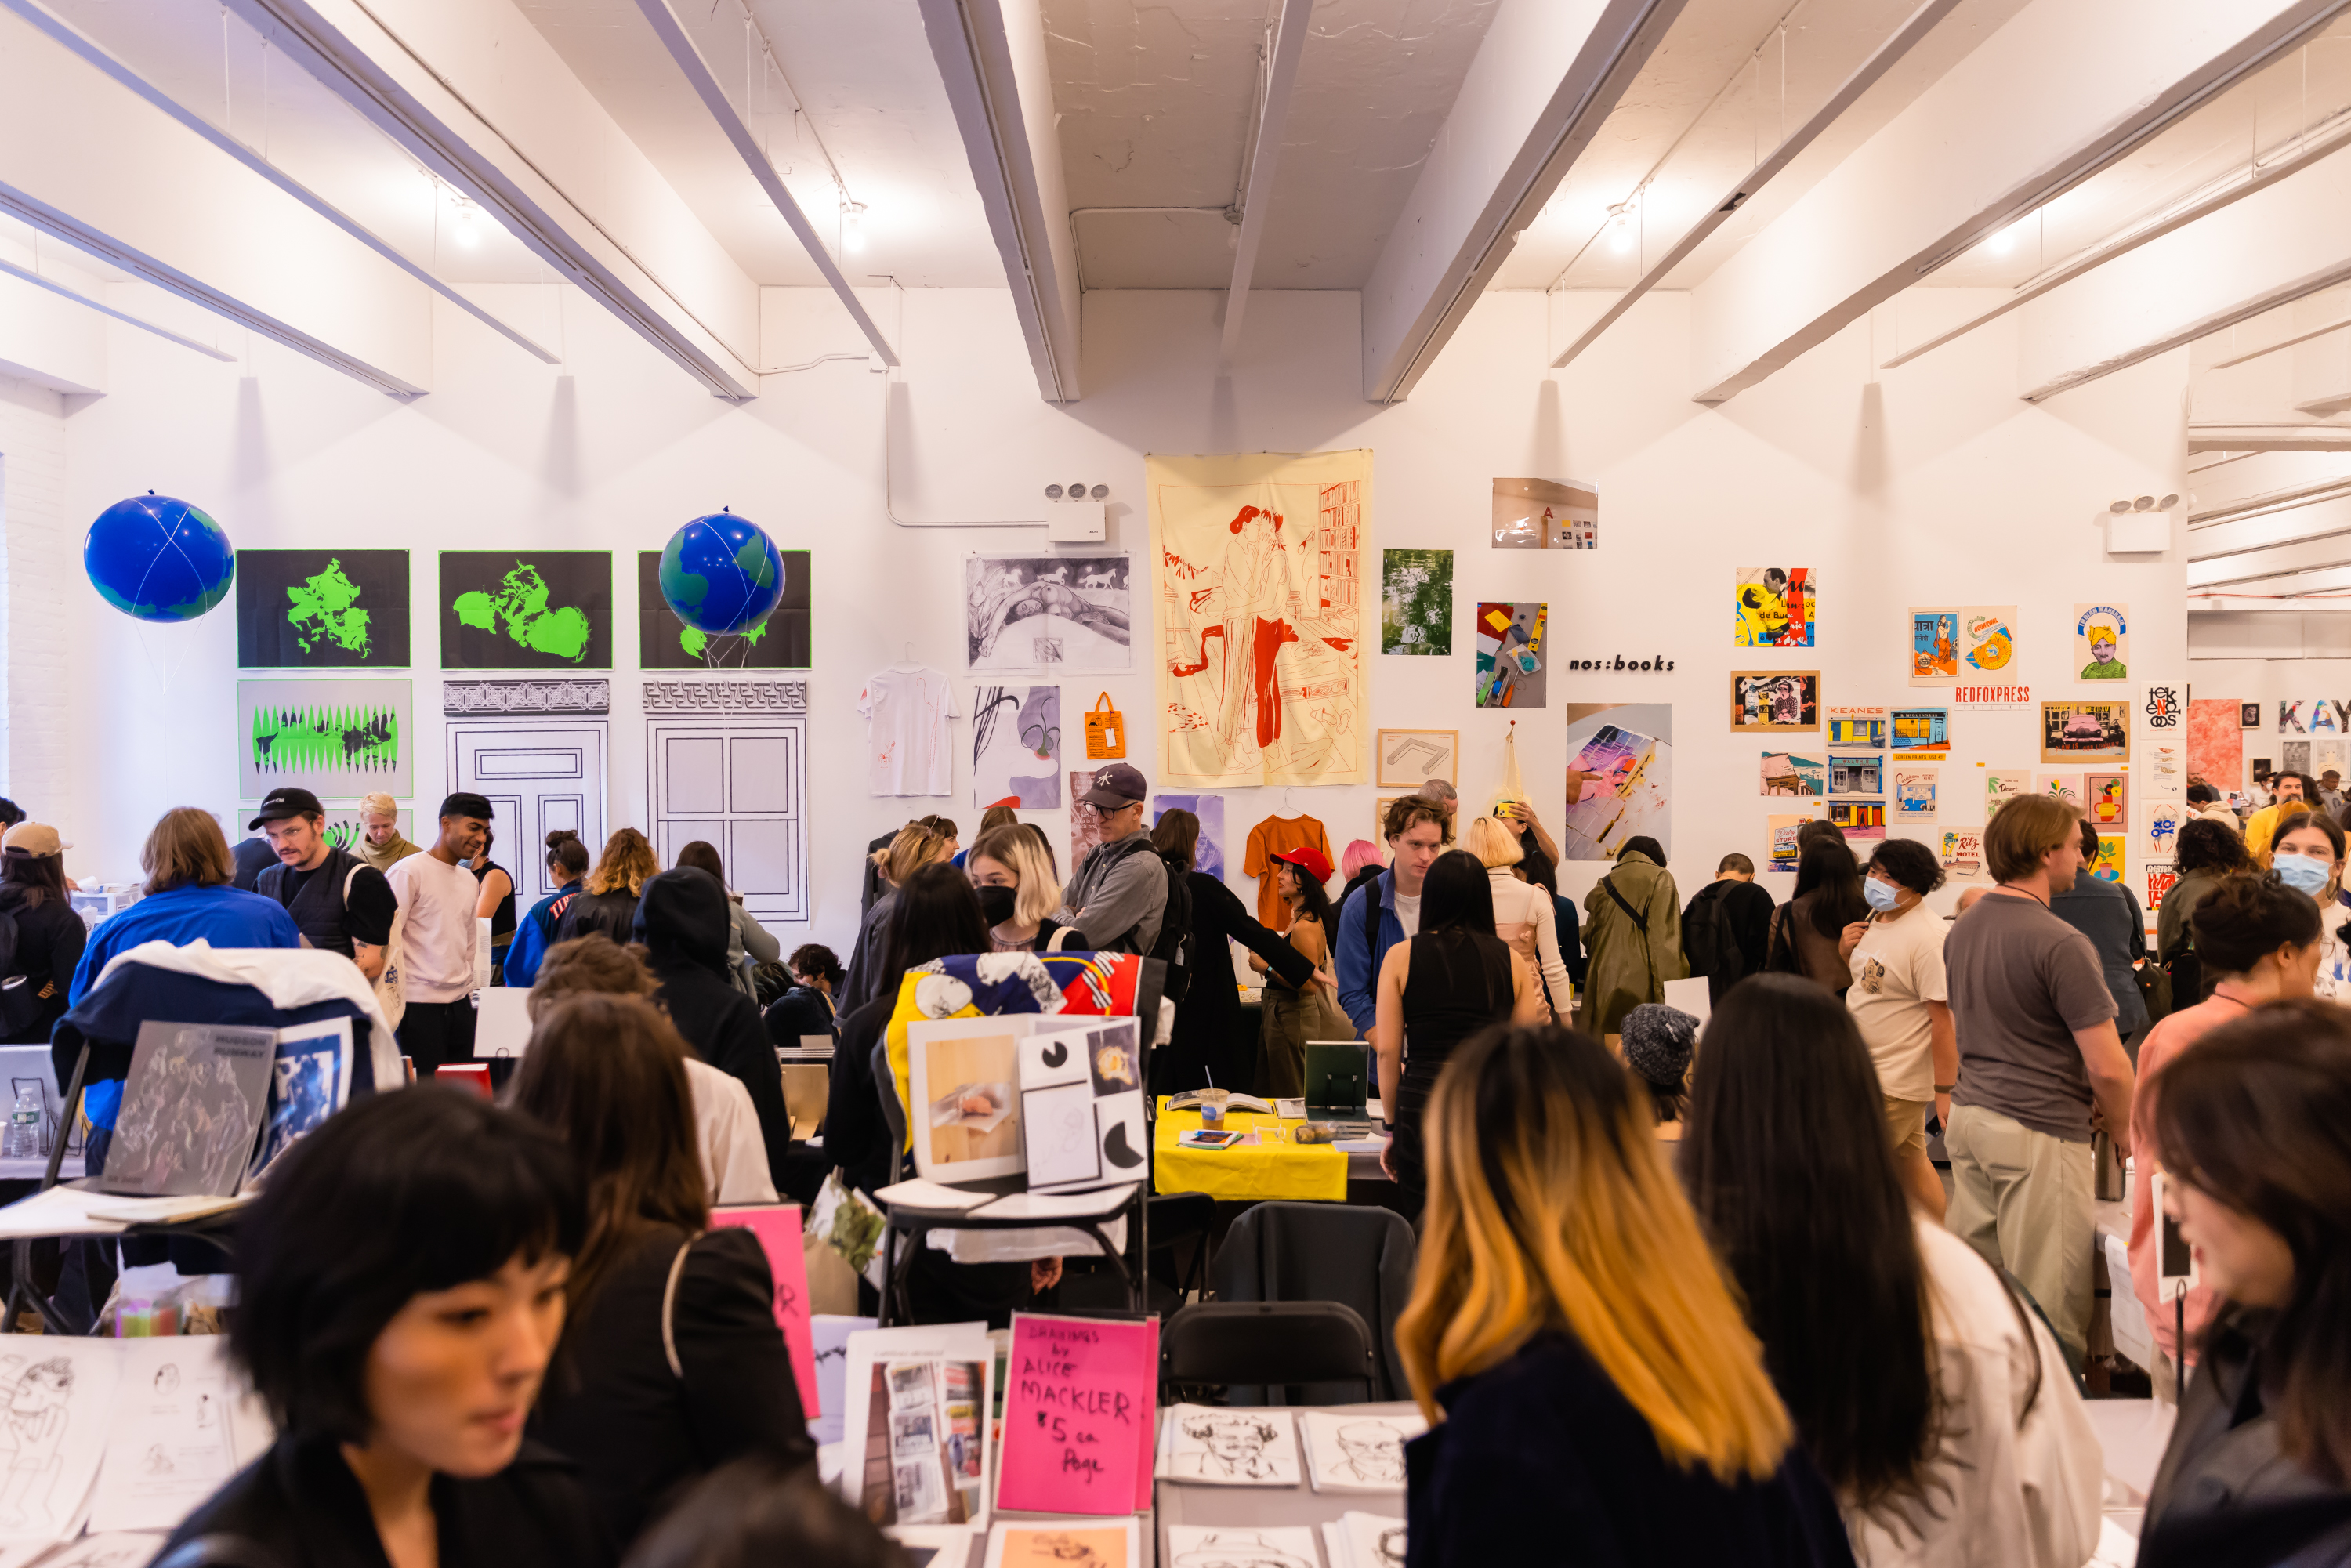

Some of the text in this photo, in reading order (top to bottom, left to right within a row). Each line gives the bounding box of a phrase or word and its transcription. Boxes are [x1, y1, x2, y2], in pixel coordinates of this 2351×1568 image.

[2079, 607, 2125, 627] INDIAN MAHARAJA
[1570, 654, 1675, 671] nos:books
[1955, 686, 2030, 702] REDFOXPRESS
[1958, 836, 1980, 850] Ritz
[1023, 1357, 1078, 1377] ALICE
[1021, 1379, 1130, 1425] MACKLER
[1063, 1447, 1104, 1483] Page
